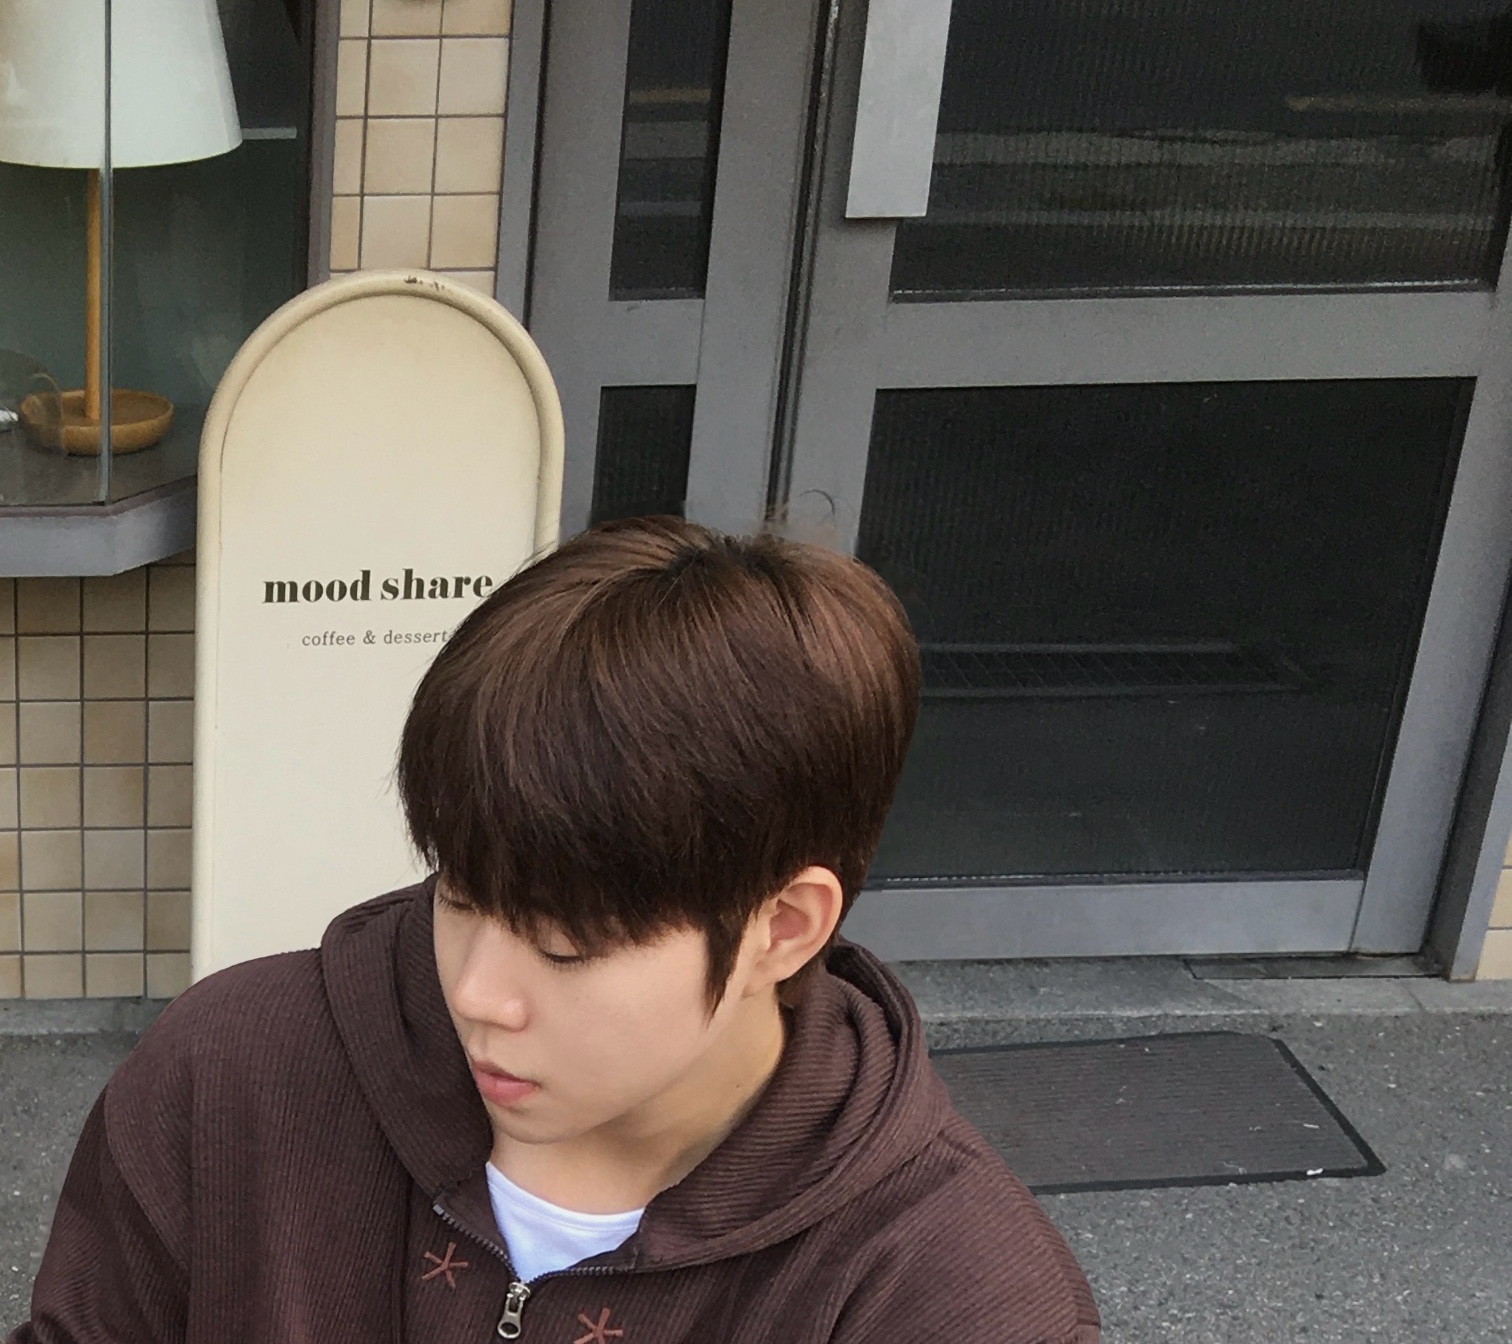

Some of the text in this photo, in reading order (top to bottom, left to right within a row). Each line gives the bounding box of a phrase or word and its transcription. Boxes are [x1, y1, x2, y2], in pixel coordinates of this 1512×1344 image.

[262, 568, 493, 603] mood share
[302, 630, 356, 646] coffee
[362, 629, 377, 645] &
